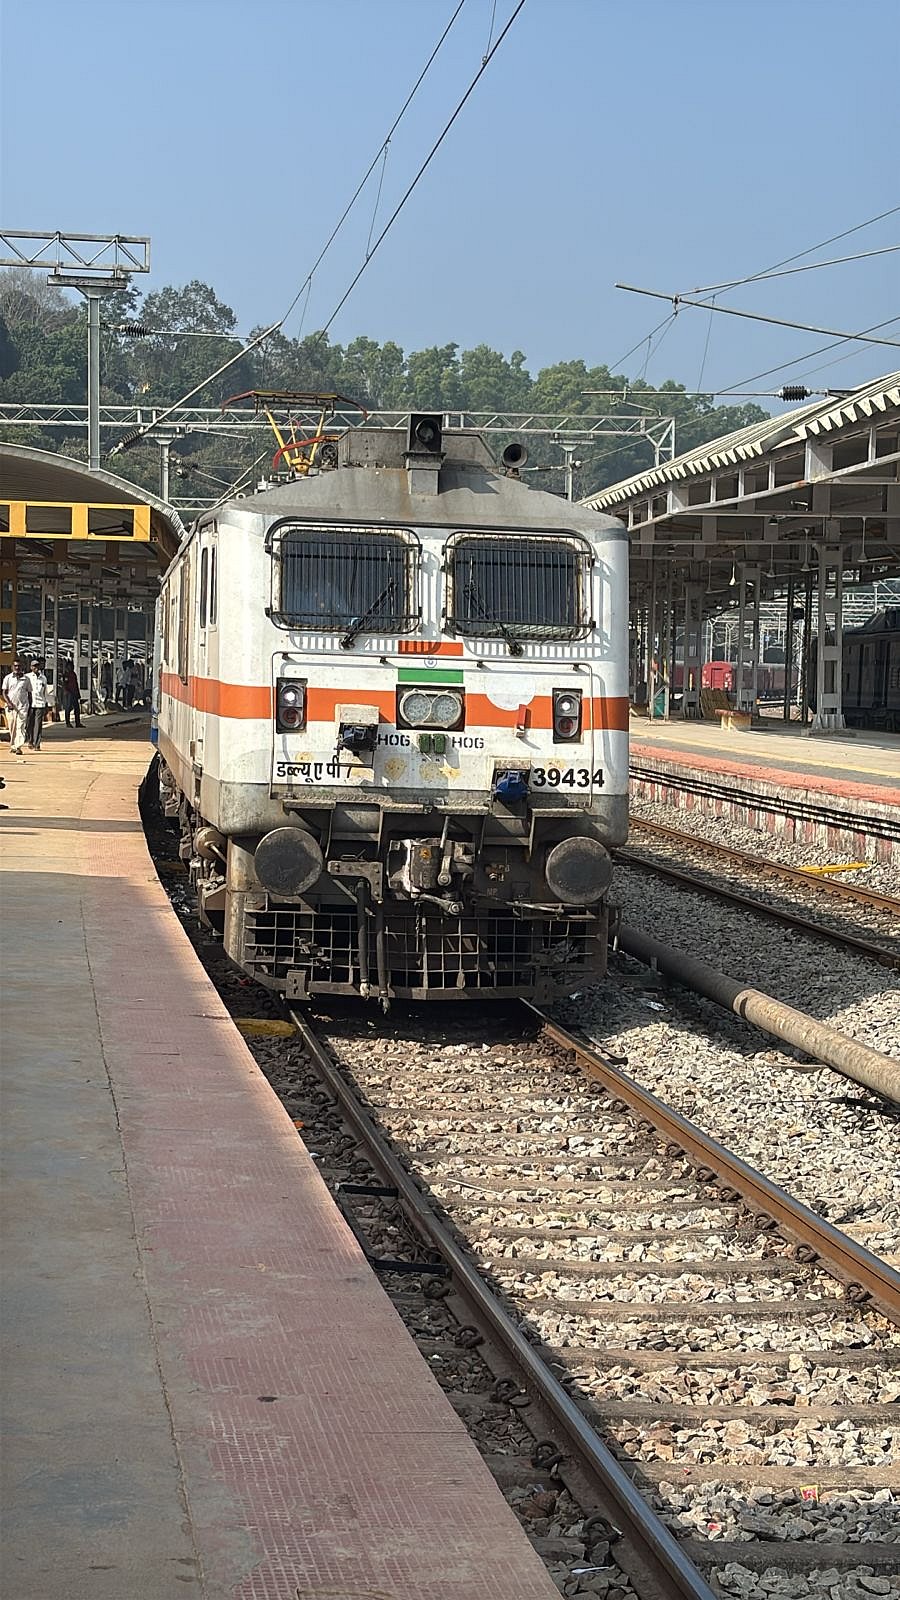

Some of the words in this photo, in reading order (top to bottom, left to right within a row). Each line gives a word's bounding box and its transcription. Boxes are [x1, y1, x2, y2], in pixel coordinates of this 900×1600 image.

[378, 733, 410, 746] HOG
[452, 736, 484, 748] HOG
[314, 763, 323, 780] ए
[326, 755, 340, 778] पी
[532, 767, 605, 788] 39434
